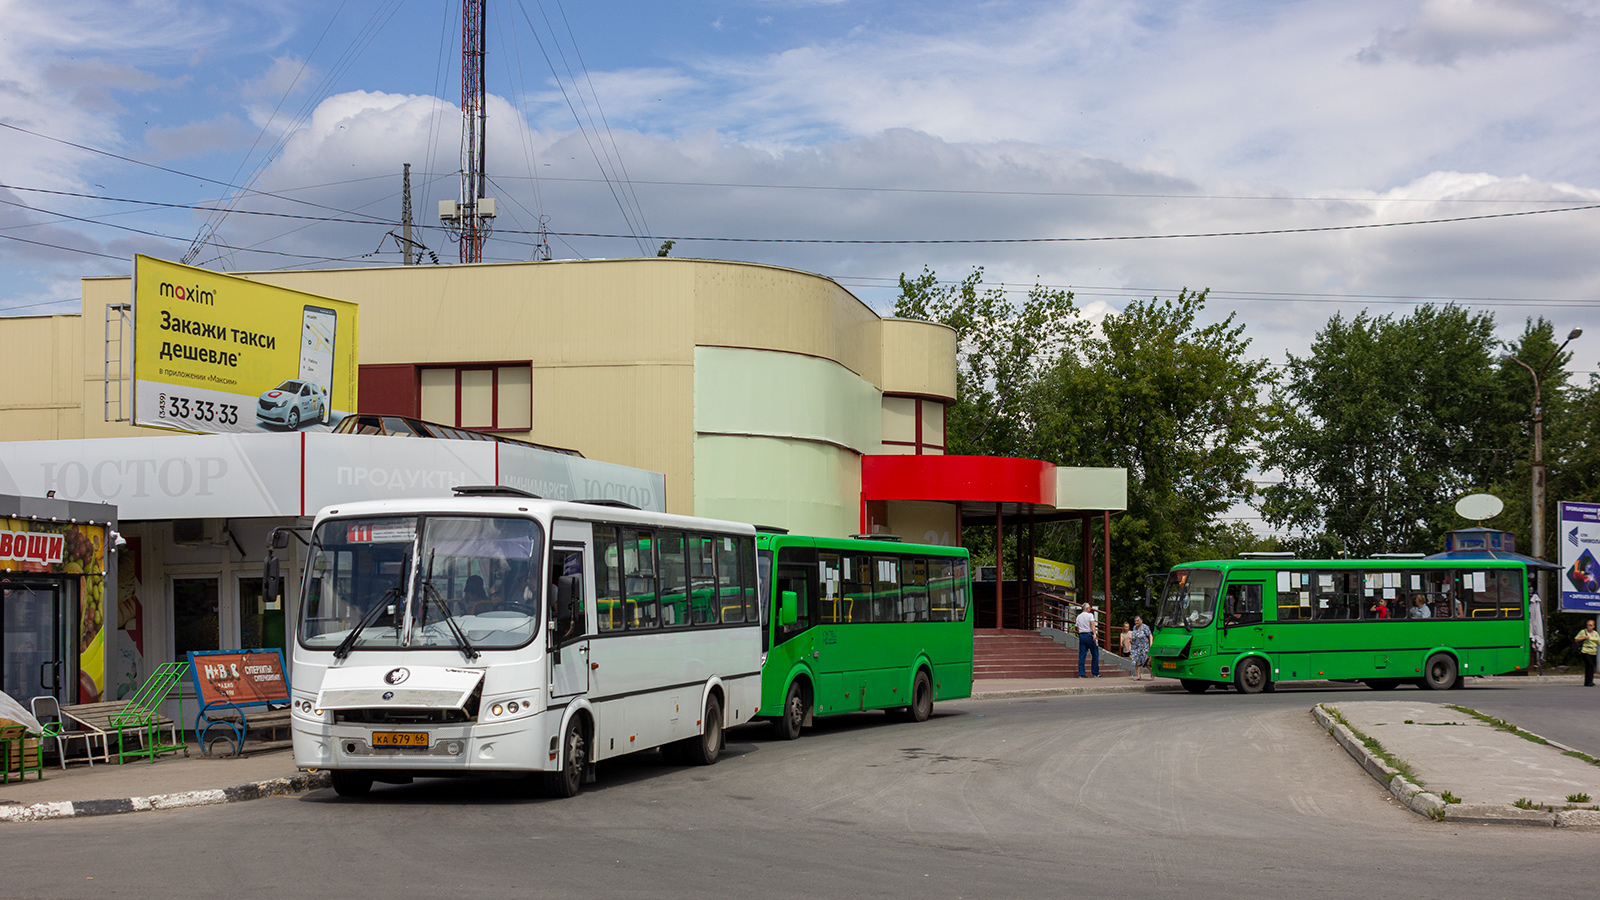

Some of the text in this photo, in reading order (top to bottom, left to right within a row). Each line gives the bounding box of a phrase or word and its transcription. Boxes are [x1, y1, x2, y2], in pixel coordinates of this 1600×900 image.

[160, 310, 276, 350] Закажи такси
[164, 369, 206, 381] приложении
[207, 375, 238, 386] «Максим»
[158, 392, 167, 418] (3439)
[40, 456, 228, 500] ЮСТОР
[336, 466, 466, 490] ПРОДУКТЫ
[504, 475, 568, 500] МИНИМАРКЕТ
[583, 477, 652, 507] ЮСТОР
[351, 524, 367, 541] 11
[377, 734, 424, 744] КА 679 66
